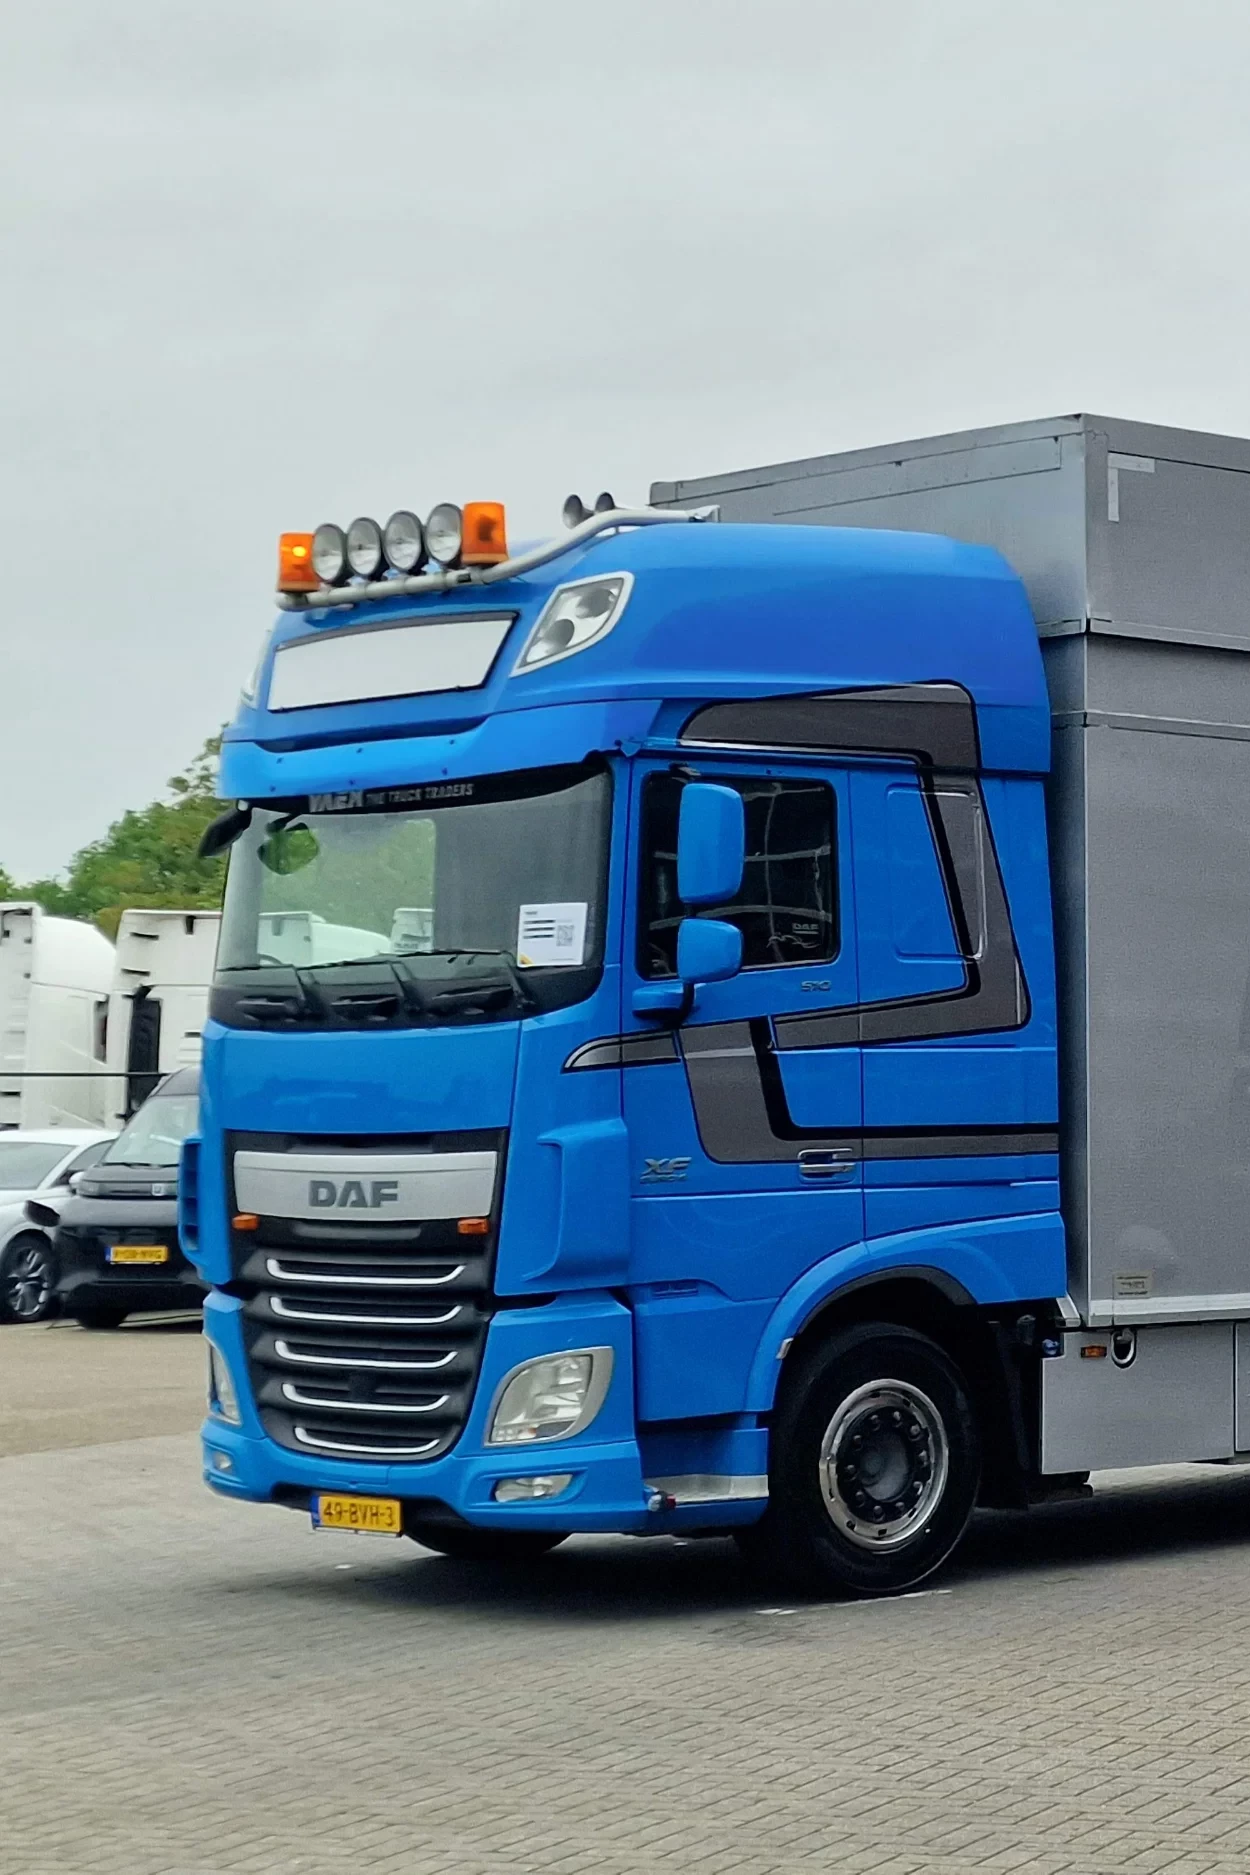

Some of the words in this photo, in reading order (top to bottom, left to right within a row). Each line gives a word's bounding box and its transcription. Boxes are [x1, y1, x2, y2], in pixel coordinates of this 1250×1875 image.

[388, 788, 422, 804] TRUCK
[424, 783, 475, 799] TRADERS
[640, 1156, 693, 1175] XF
[308, 1180, 399, 1208] DAF
[323, 1502, 395, 1527] 49-BVH-3
